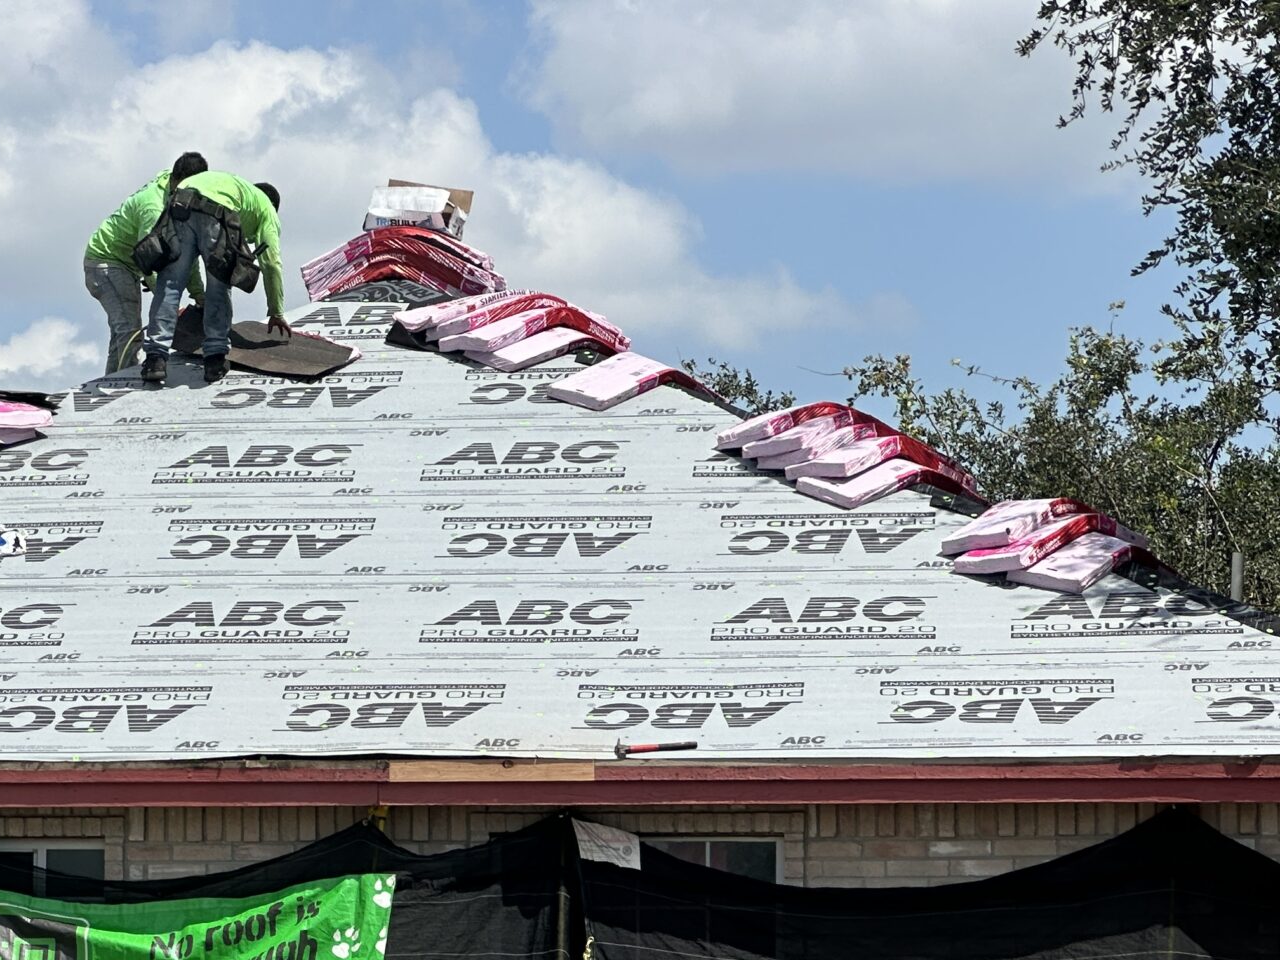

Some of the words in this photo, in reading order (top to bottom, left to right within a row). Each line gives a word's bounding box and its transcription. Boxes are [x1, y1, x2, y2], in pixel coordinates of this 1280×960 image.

[291, 306, 399, 327] AB
[210, 385, 386, 410] ABC
[169, 445, 353, 468] ABC
[437, 441, 624, 465] ABC
[766, 519, 869, 527] GUARD
[879, 518, 936, 527] PRO
[171, 534, 359, 559] ABC
[444, 533, 635, 558] ABC
[726, 529, 924, 555] ABC
[149, 601, 347, 626] ABC
[437, 599, 637, 624] ABC
[729, 597, 927, 623] ABC
[1011, 624, 1071, 632] PRO
[1082, 621, 1193, 631] GUARD
[618, 648, 662, 656] ABC
[556, 670, 599, 678] ABC
[331, 691, 436, 699] GUARD
[626, 690, 734, 699] GUARD
[744, 689, 804, 697] PRO
[880, 688, 918, 696] 20
[930, 687, 1041, 696] GUARD
[1052, 686, 1114, 694] PRO
[37, 694, 142, 702] GUARD
[152, 693, 210, 701] PRO
[282, 692, 319, 700] 20
[285, 703, 488, 729] ABC
[580, 701, 785, 728] ABC
[890, 698, 1100, 725] ABC
[782, 736, 826, 744] ABC
[150, 933, 194, 960] No
[205, 901, 284, 952] roof
[296, 896, 322, 926] is
